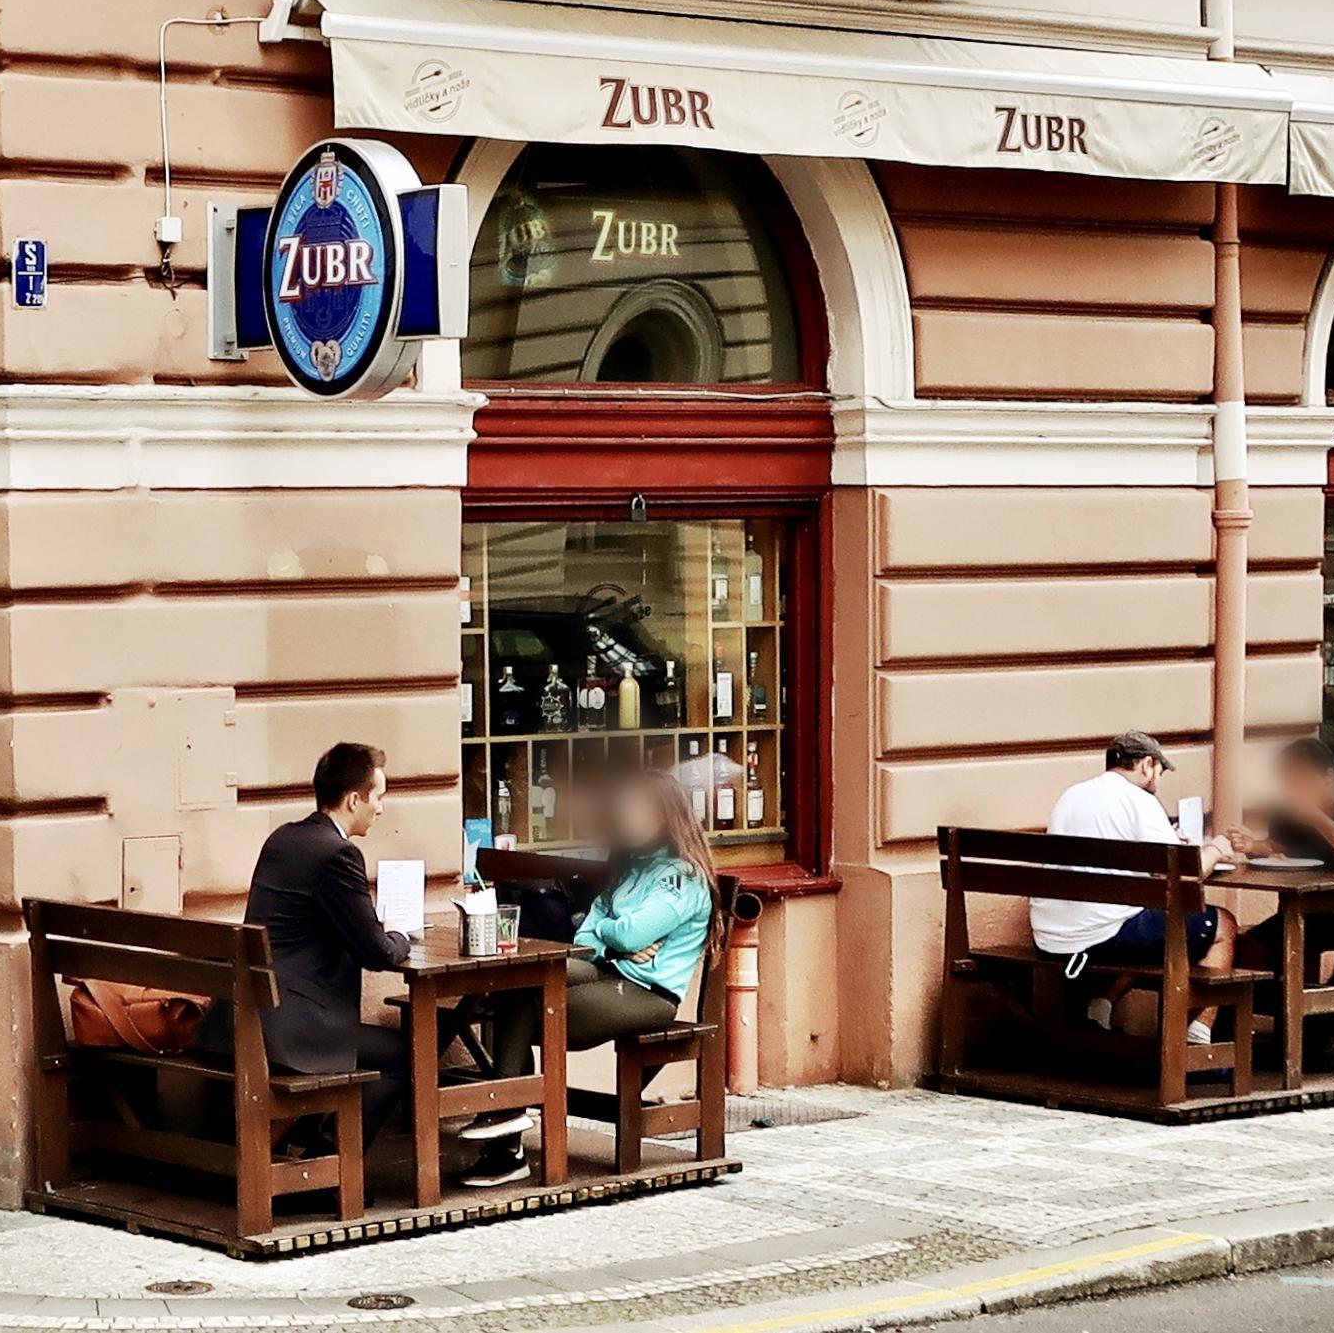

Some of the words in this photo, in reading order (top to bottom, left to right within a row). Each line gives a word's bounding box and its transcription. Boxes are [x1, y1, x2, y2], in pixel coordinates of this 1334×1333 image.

[599, 76, 716, 130] ZUBR
[994, 106, 1089, 155] ZUBR
[591, 209, 681, 262] ZUBR
[277, 234, 379, 303] ZUBR
